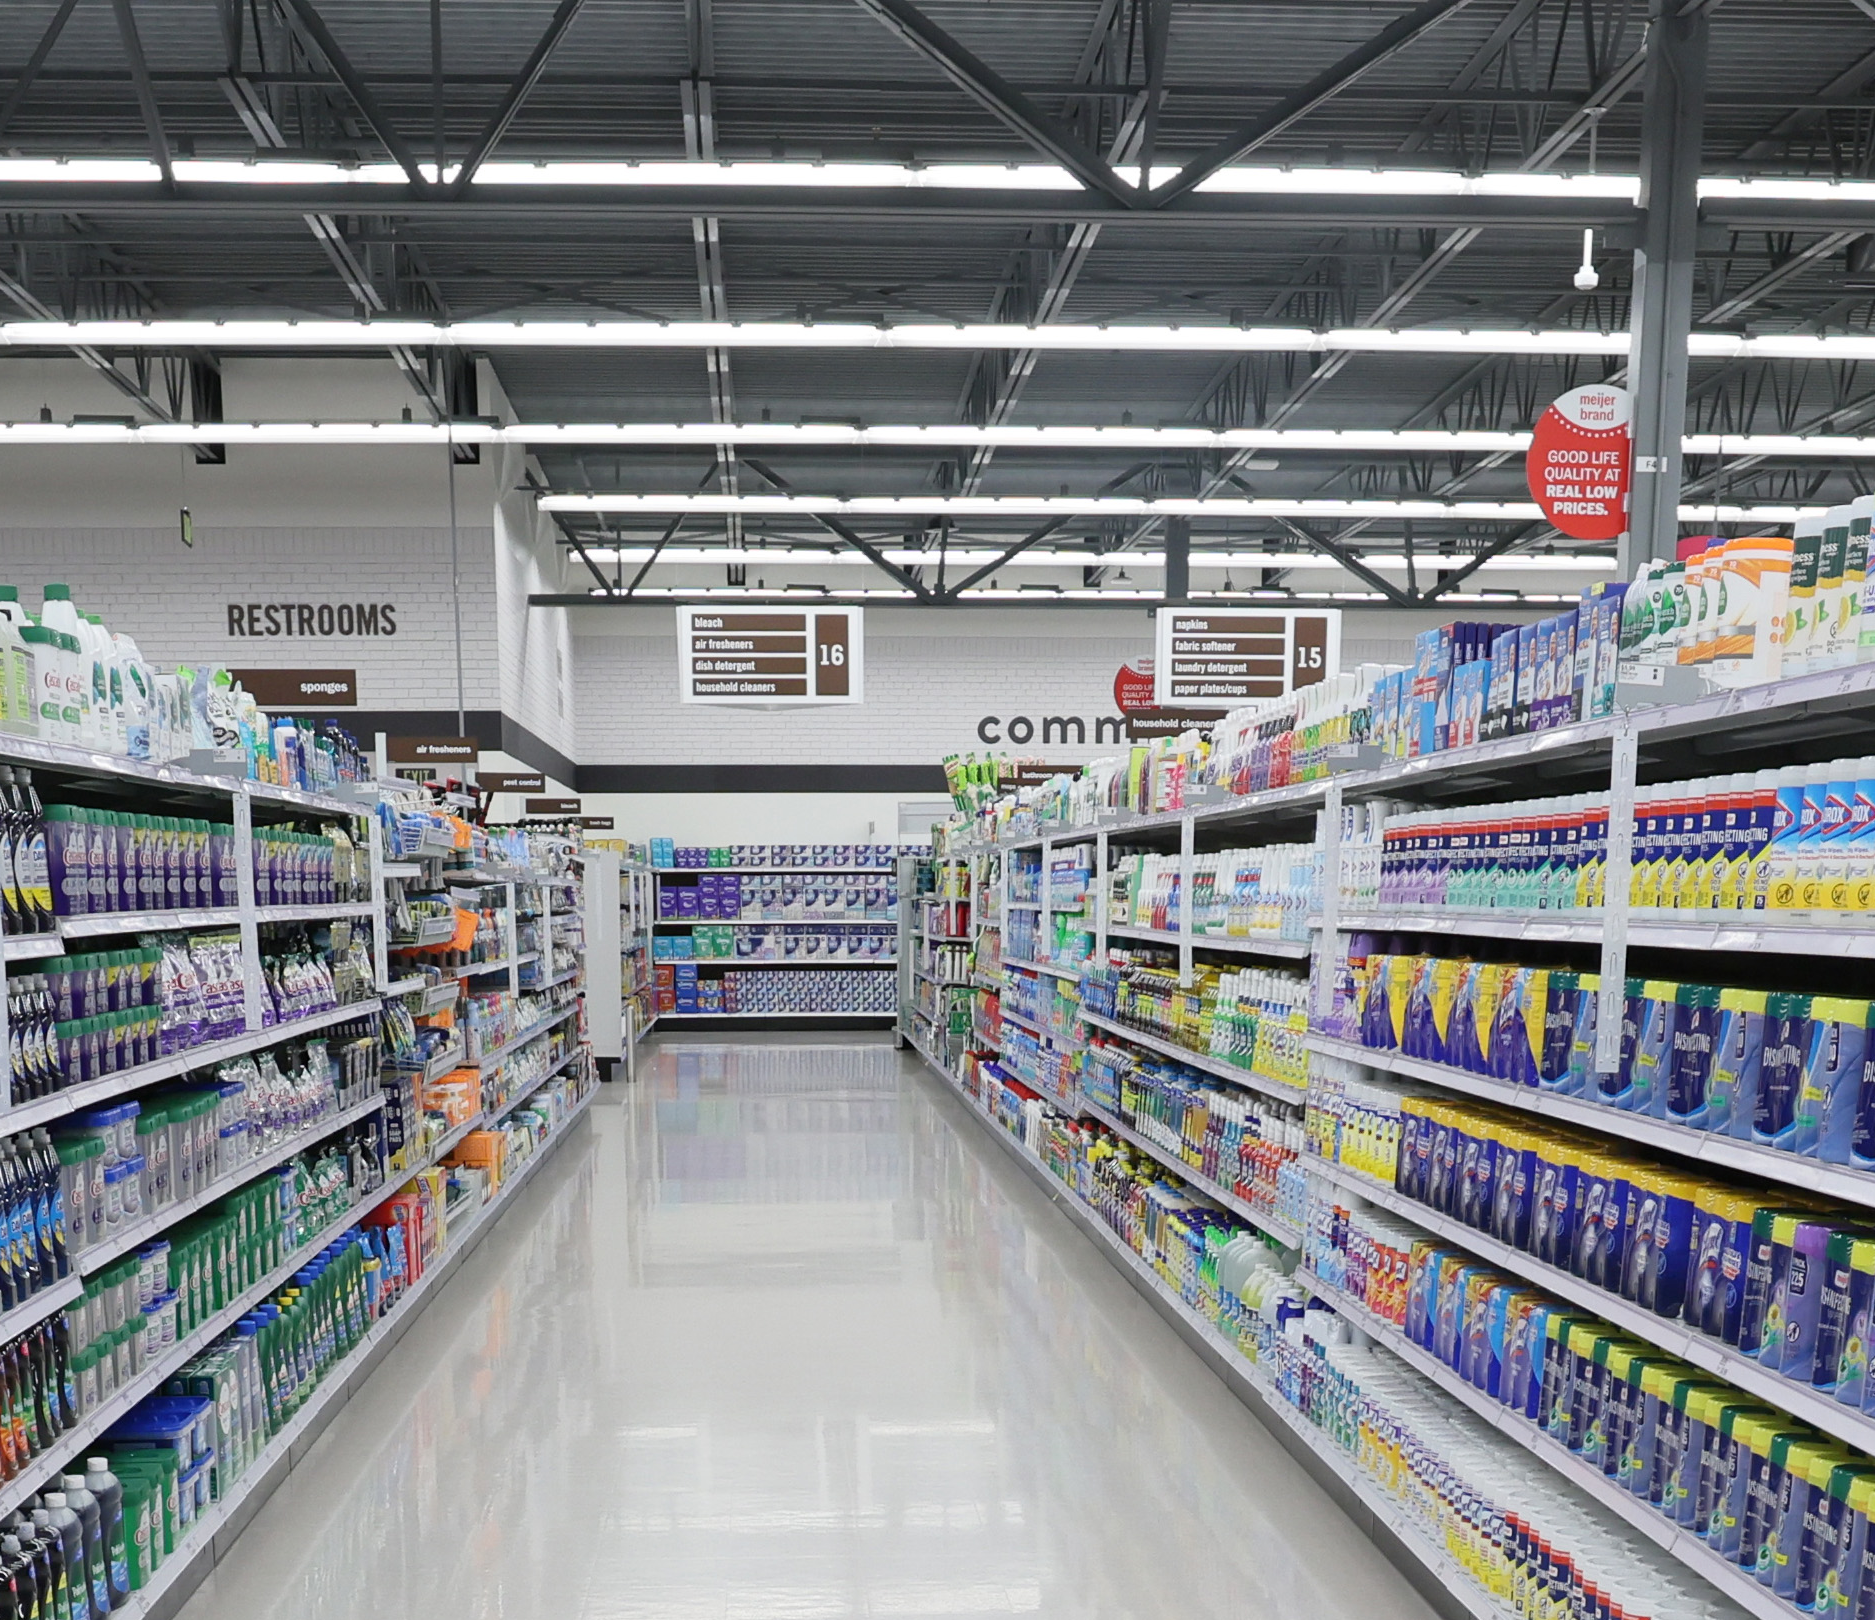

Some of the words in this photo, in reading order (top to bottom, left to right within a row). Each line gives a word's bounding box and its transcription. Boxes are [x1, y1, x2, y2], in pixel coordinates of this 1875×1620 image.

[1580, 393, 1616, 408] meijer
[1580, 408, 1614, 421] brand
[1548, 450, 1588, 464] GOOD
[1592, 452, 1619, 465] LIFE
[1544, 467, 1601, 482] QUALITY
[1604, 468, 1621, 482] AT
[1546, 485, 1582, 498] REAL
[1586, 486, 1618, 499] LOW
[1553, 502, 1609, 516] PRICES.
[228, 604, 397, 636] RESTROOMS
[695, 617, 723, 628] bleach
[1176, 619, 1208, 631] napkins
[695, 639, 707, 649] air
[709, 639, 754, 650] fresheners
[1175, 641, 1200, 651] fabric
[1202, 641, 1236, 651] softener
[820, 644, 844, 667] 16
[1298, 647, 1322, 668] 15
[695, 661, 713, 671] dish
[714, 661, 756, 672] detergent
[1175, 662, 1206, 674] laundry
[1207, 663, 1247, 674] detergent
[300, 680, 349, 695] sponges
[696, 682, 738, 692] household
[740, 682, 776, 692] cleaners
[1175, 684, 1198, 695] paper
[1200, 683, 1247, 695] plates/cups
[1133, 719, 1178, 728] household
[1181, 719, 1217, 728] cleaner
[416, 744, 428, 754] air
[429, 744, 472, 755] fresheners
